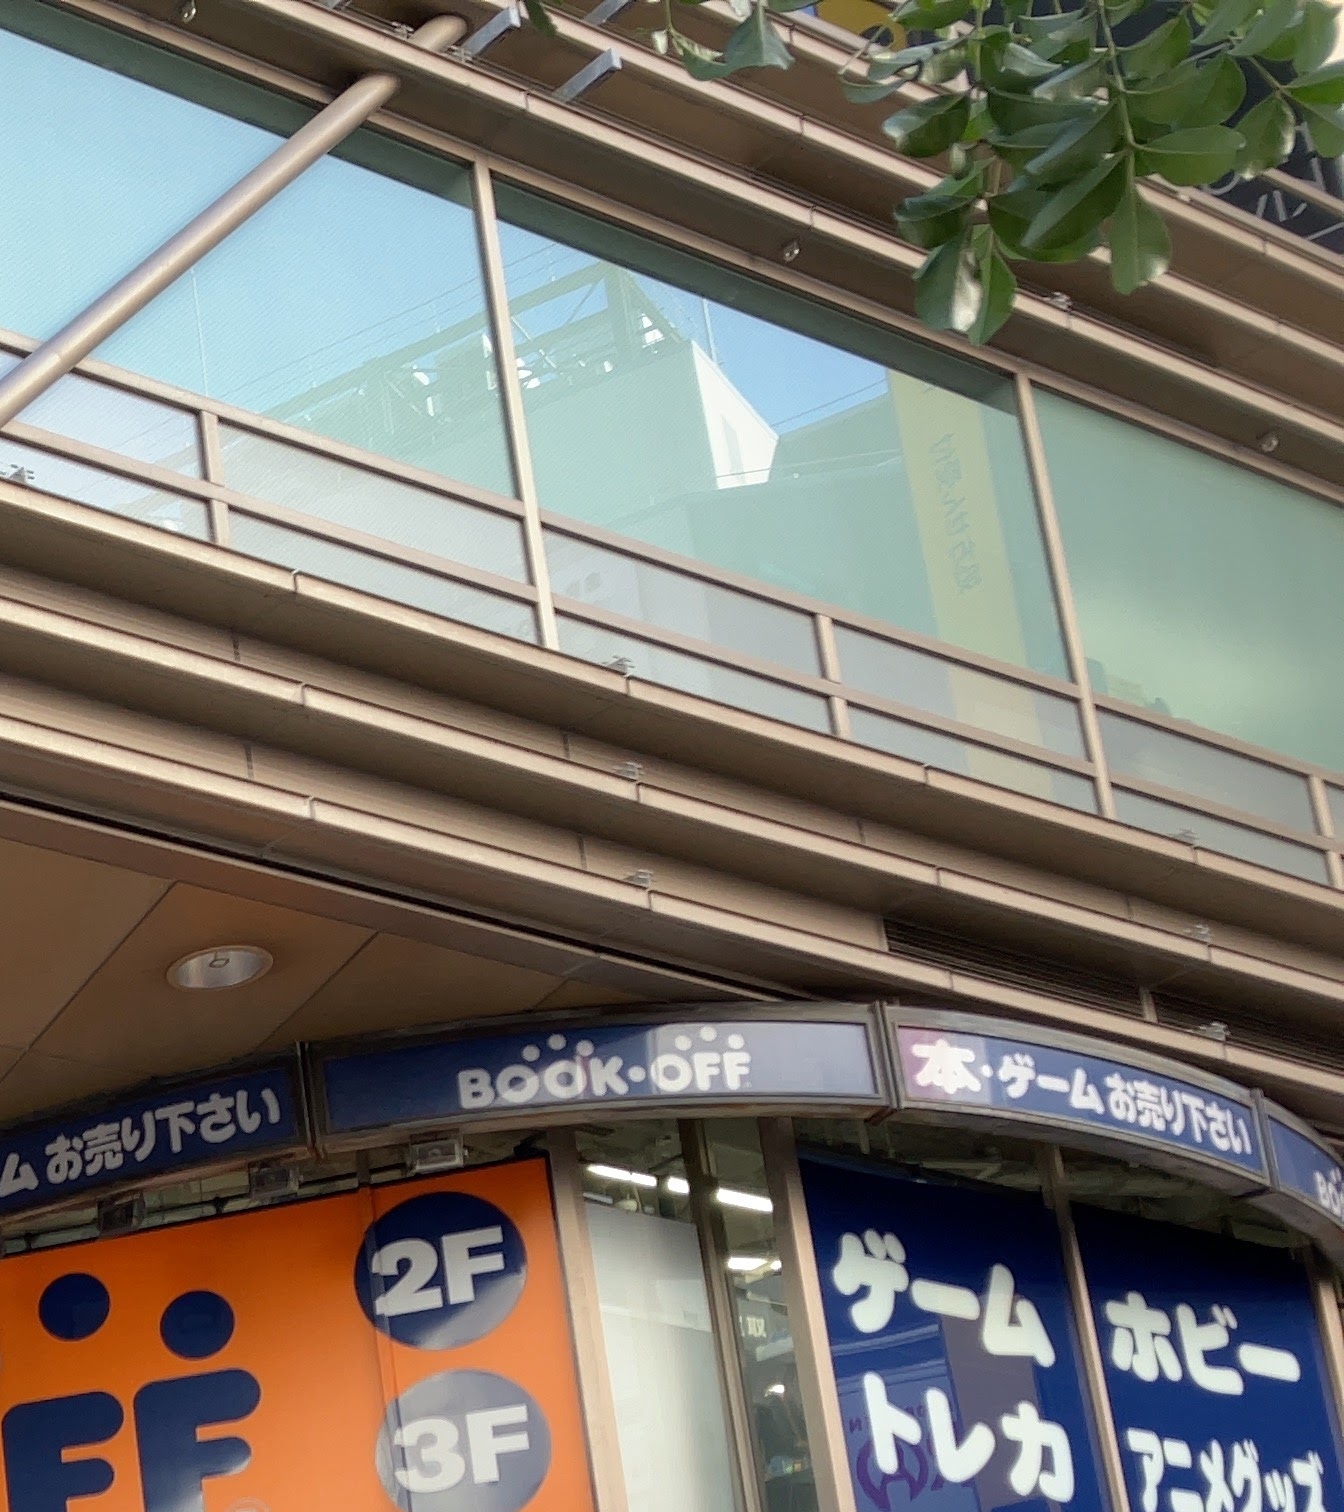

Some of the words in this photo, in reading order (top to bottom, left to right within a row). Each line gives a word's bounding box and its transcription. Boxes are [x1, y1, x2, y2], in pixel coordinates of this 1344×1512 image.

[45, 1087, 282, 1182] お売り下さい
[912, 1039, 1104, 1112] 本・ゲーム
[1108, 1071, 1253, 1156] お売り下さい
[370, 1227, 506, 1316] 2F
[832, 1228, 1055, 1367] ゲーム
[1105, 1290, 1301, 1396] ホビー
[394, 1406, 530, 1493] 3F
[863, 1371, 1075, 1504] トレカ
